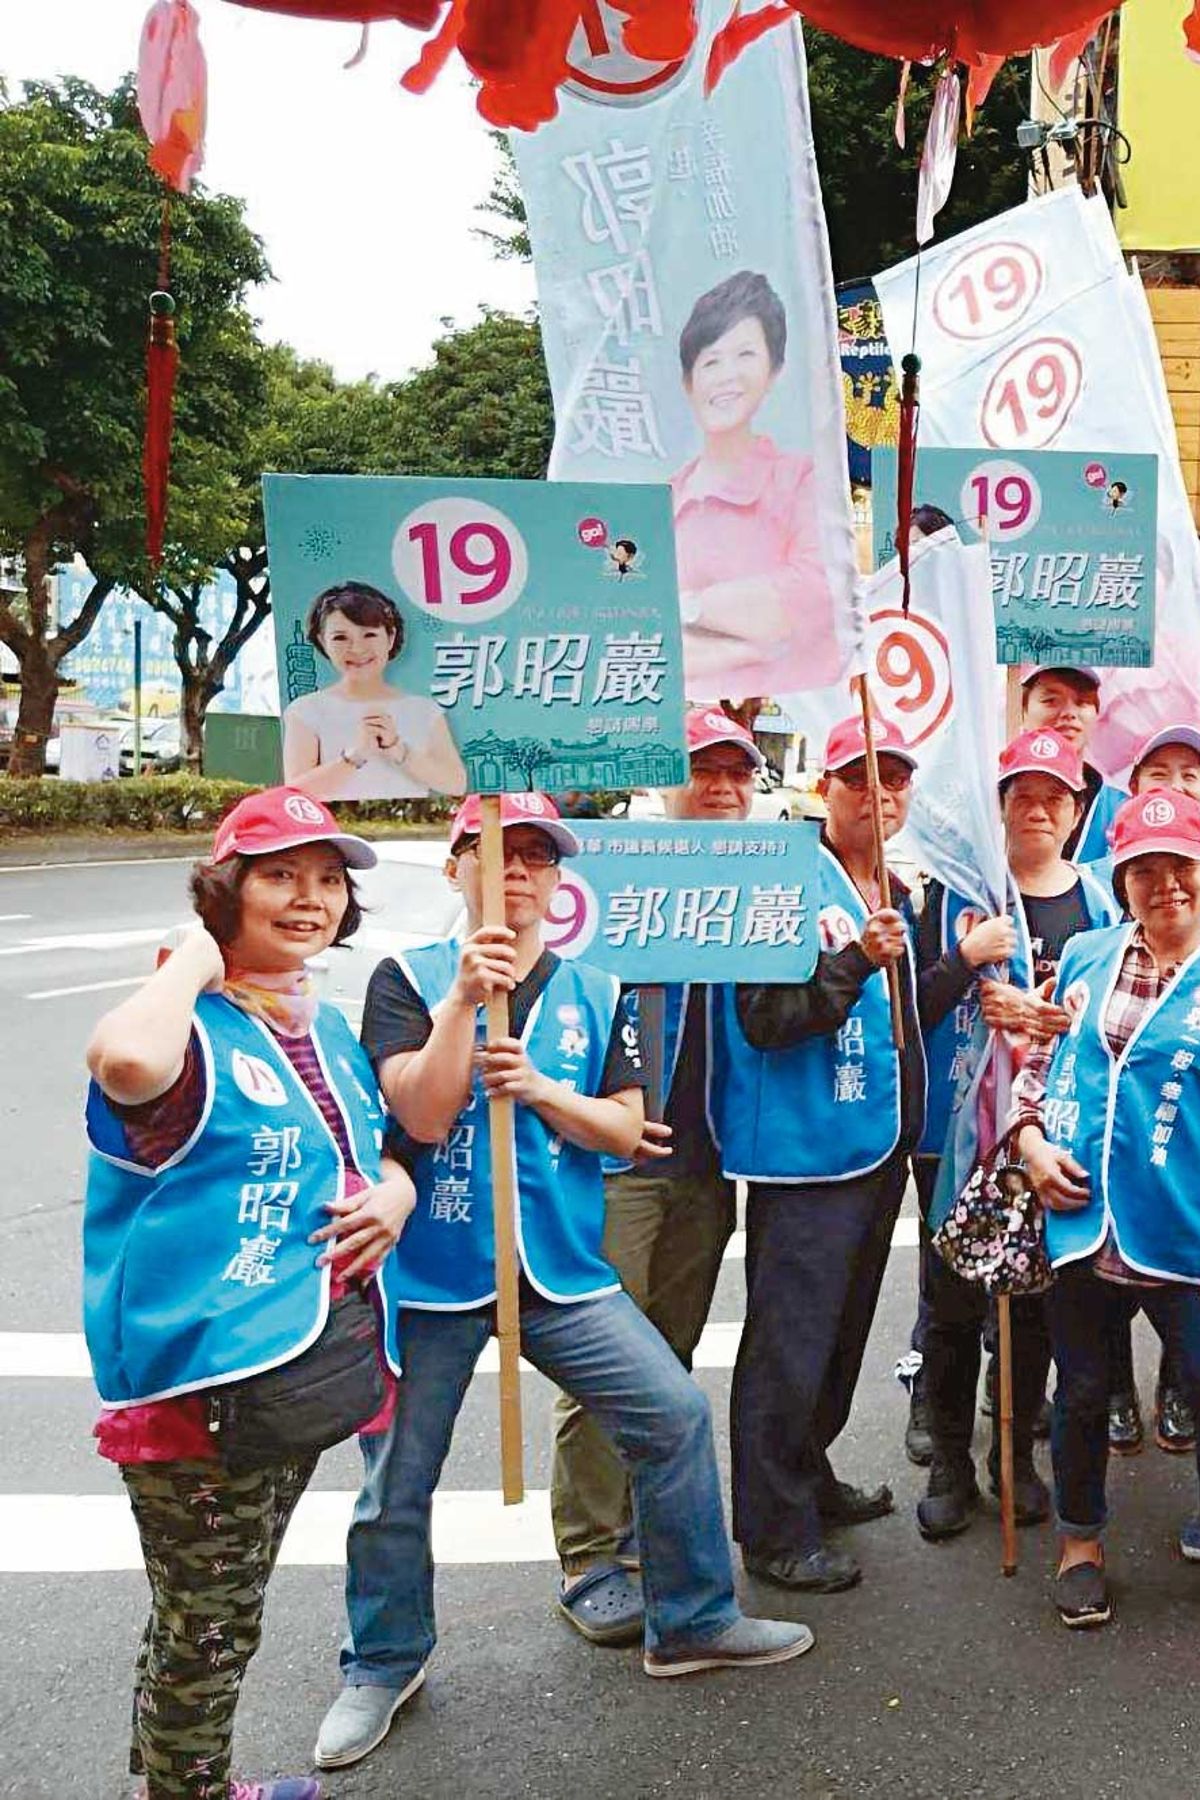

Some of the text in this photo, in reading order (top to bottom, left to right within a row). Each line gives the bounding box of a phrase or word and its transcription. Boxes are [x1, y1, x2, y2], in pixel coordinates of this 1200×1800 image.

[949, 254, 1027, 326] 19
[996, 354, 1067, 437] 19
[970, 475, 1032, 530] 19
[408, 522, 512, 605] 19
[430, 631, 667, 709] 郭昭巖
[876, 630, 936, 713] 9
[603, 883, 808, 949] 郭昭巖
[834, 1015, 867, 1103] 昭巖
[429, 1097, 477, 1223] 昭巖
[221, 1124, 302, 1288] 郭昭巖
